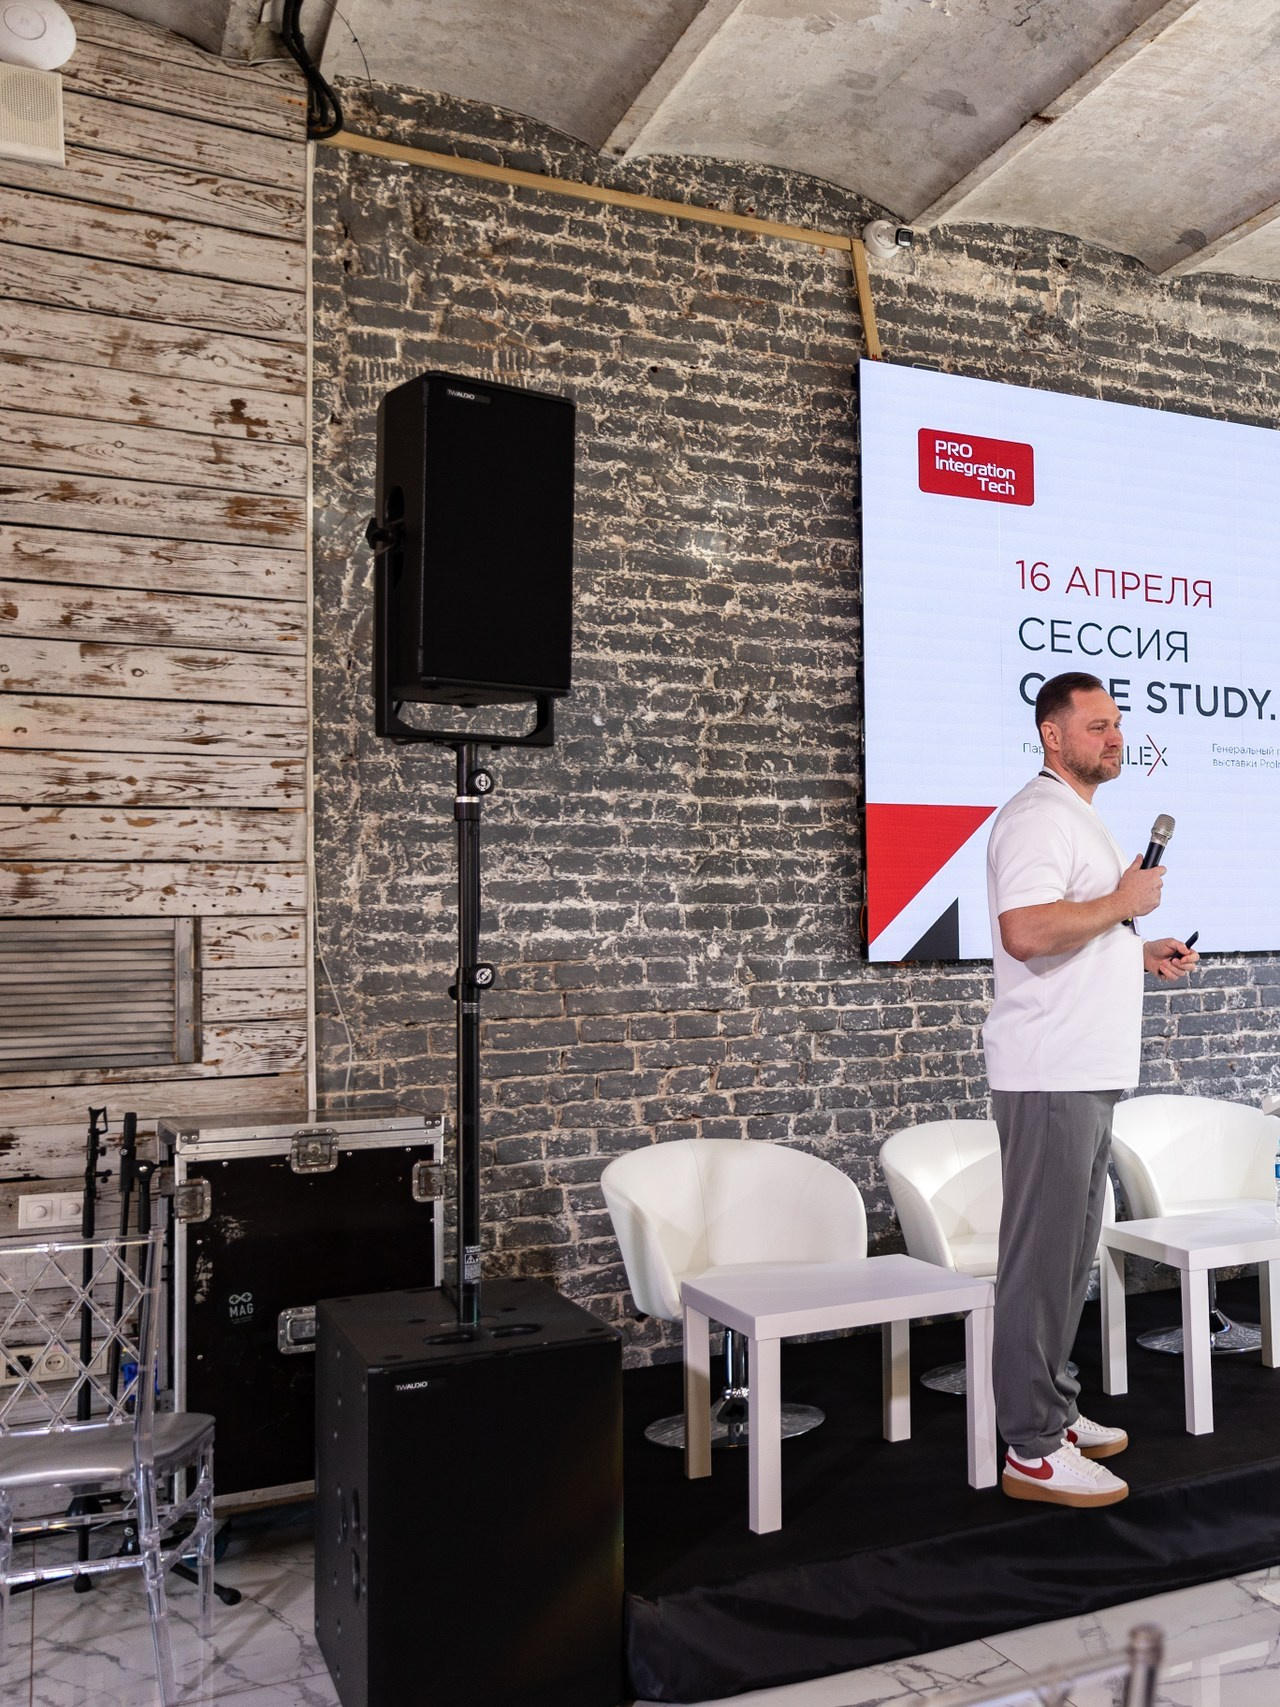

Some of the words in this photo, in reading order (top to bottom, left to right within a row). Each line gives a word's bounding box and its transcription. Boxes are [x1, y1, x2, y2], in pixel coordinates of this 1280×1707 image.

[935, 440, 973, 458] PRO
[935, 455, 1016, 480] Integration
[976, 477, 1015, 496] Tech
[1016, 560, 1051, 592] 16
[1065, 566, 1213, 608] АПРЕЛЯ
[1018, 617, 1189, 663] СЕССИЯ
[1019, 672, 1131, 712] CE
[1146, 681, 1276, 720] STUDY.
[1212, 743, 1275, 757] Генеральный
[1212, 758, 1258, 768] выставки
[229, 1302, 254, 1318] MAG
